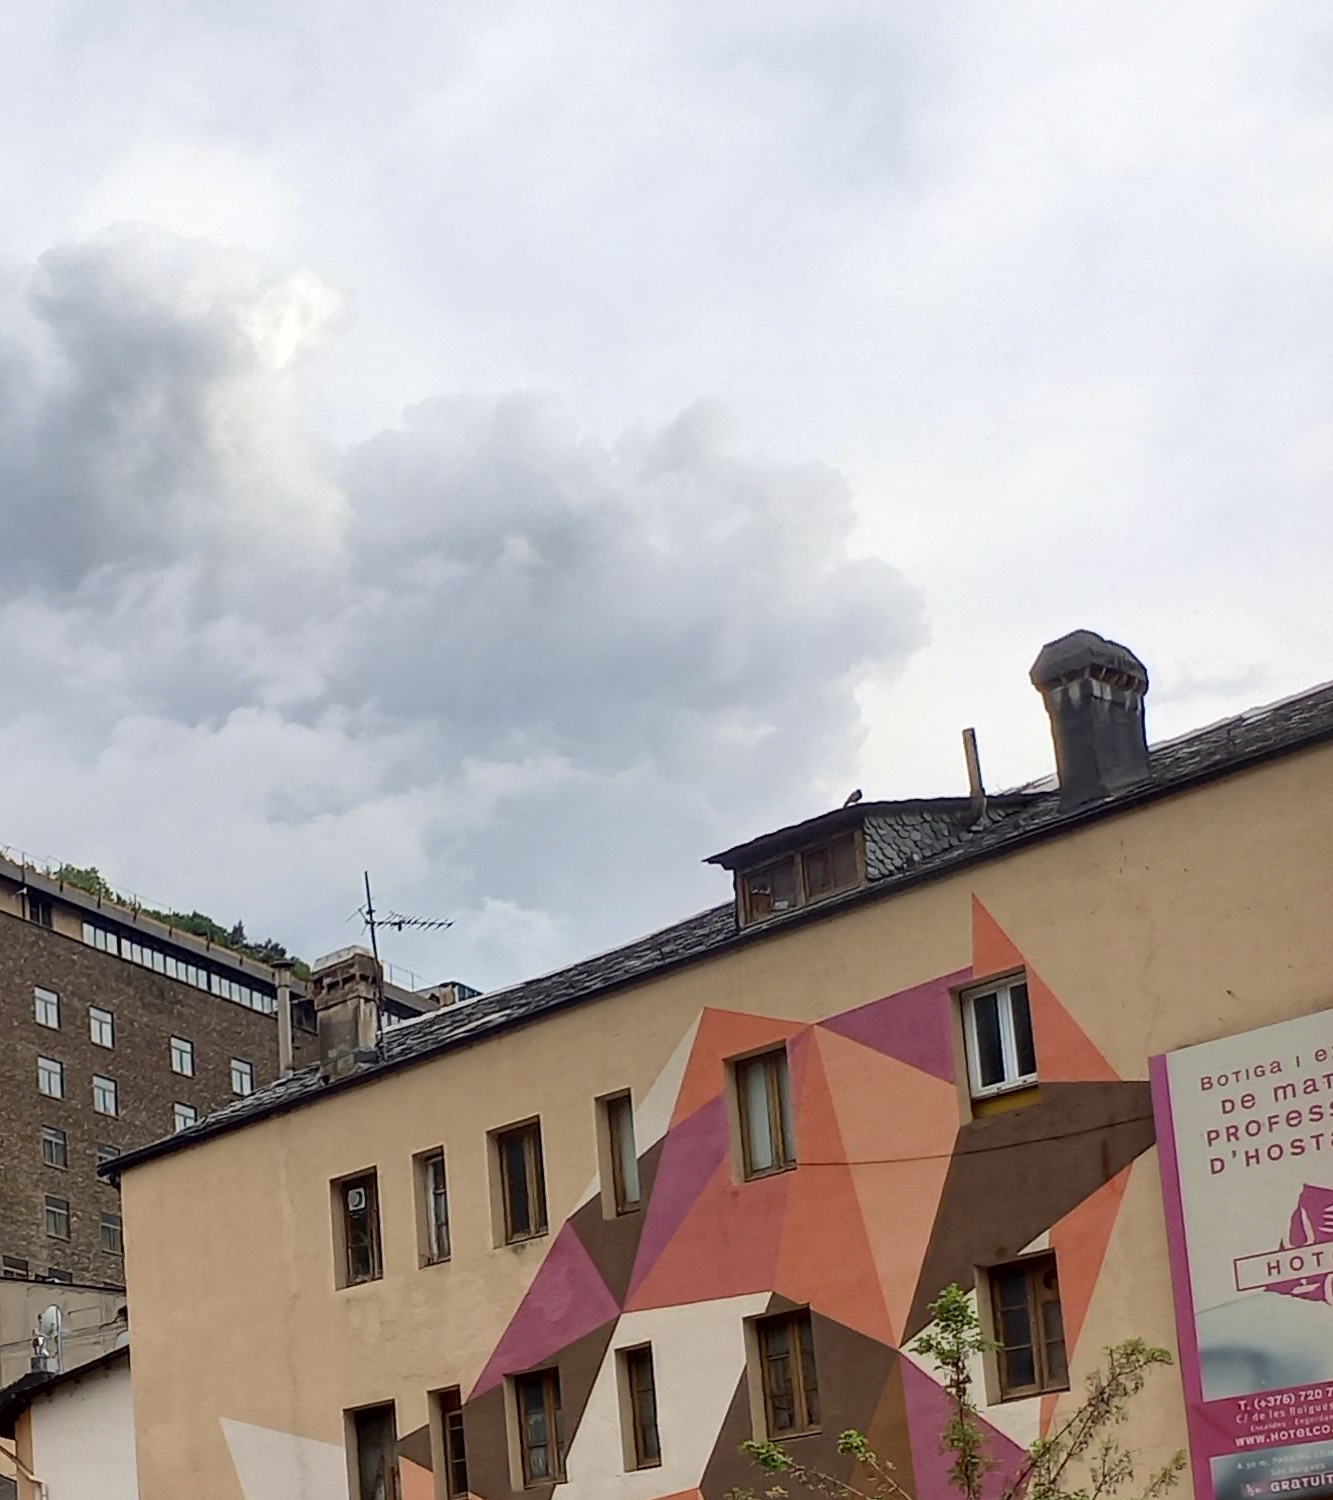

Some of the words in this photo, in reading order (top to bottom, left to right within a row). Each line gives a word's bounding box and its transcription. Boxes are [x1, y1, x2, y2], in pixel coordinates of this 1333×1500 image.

[1209, 1132, 1333, 1175] D'HOST
[1253, 1392, 1295, 1410] (+376)
[1298, 1389, 1323, 1402] 720
